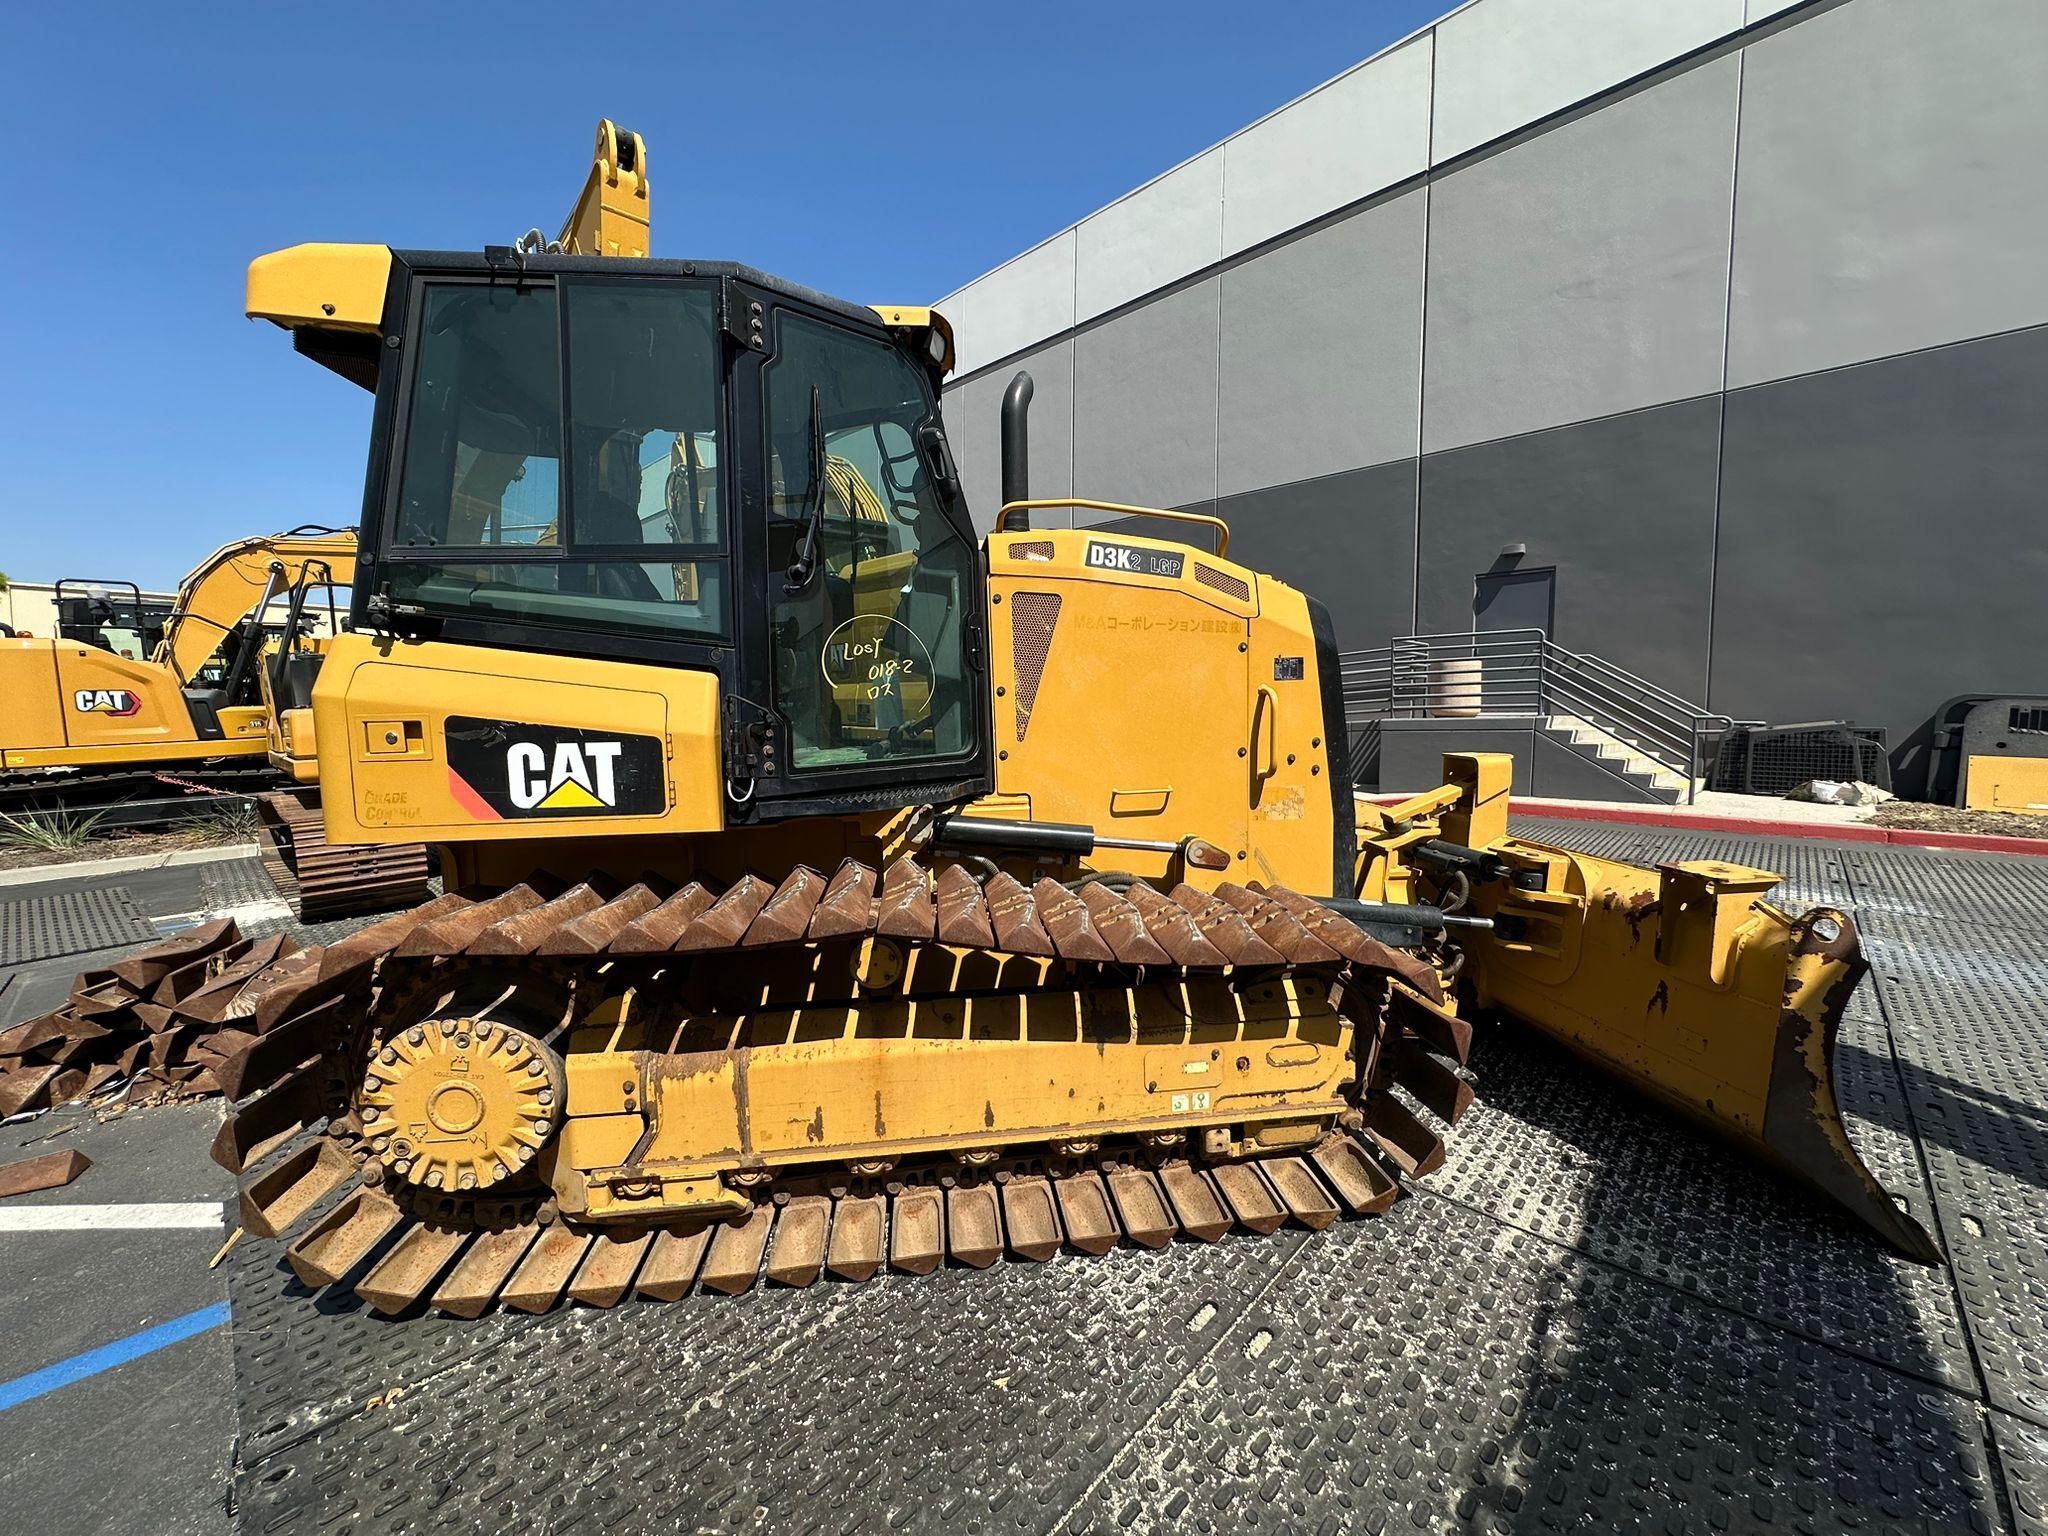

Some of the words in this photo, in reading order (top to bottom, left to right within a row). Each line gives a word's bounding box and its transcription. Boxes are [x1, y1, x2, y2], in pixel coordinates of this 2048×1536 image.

[1090, 544, 1141, 571] D3K2
[1150, 557, 1181, 575] LGP
[203, 669, 222, 681] AT
[868, 659, 914, 680] 018-2
[75, 690, 125, 712] CAT
[507, 741, 622, 809] CAT
